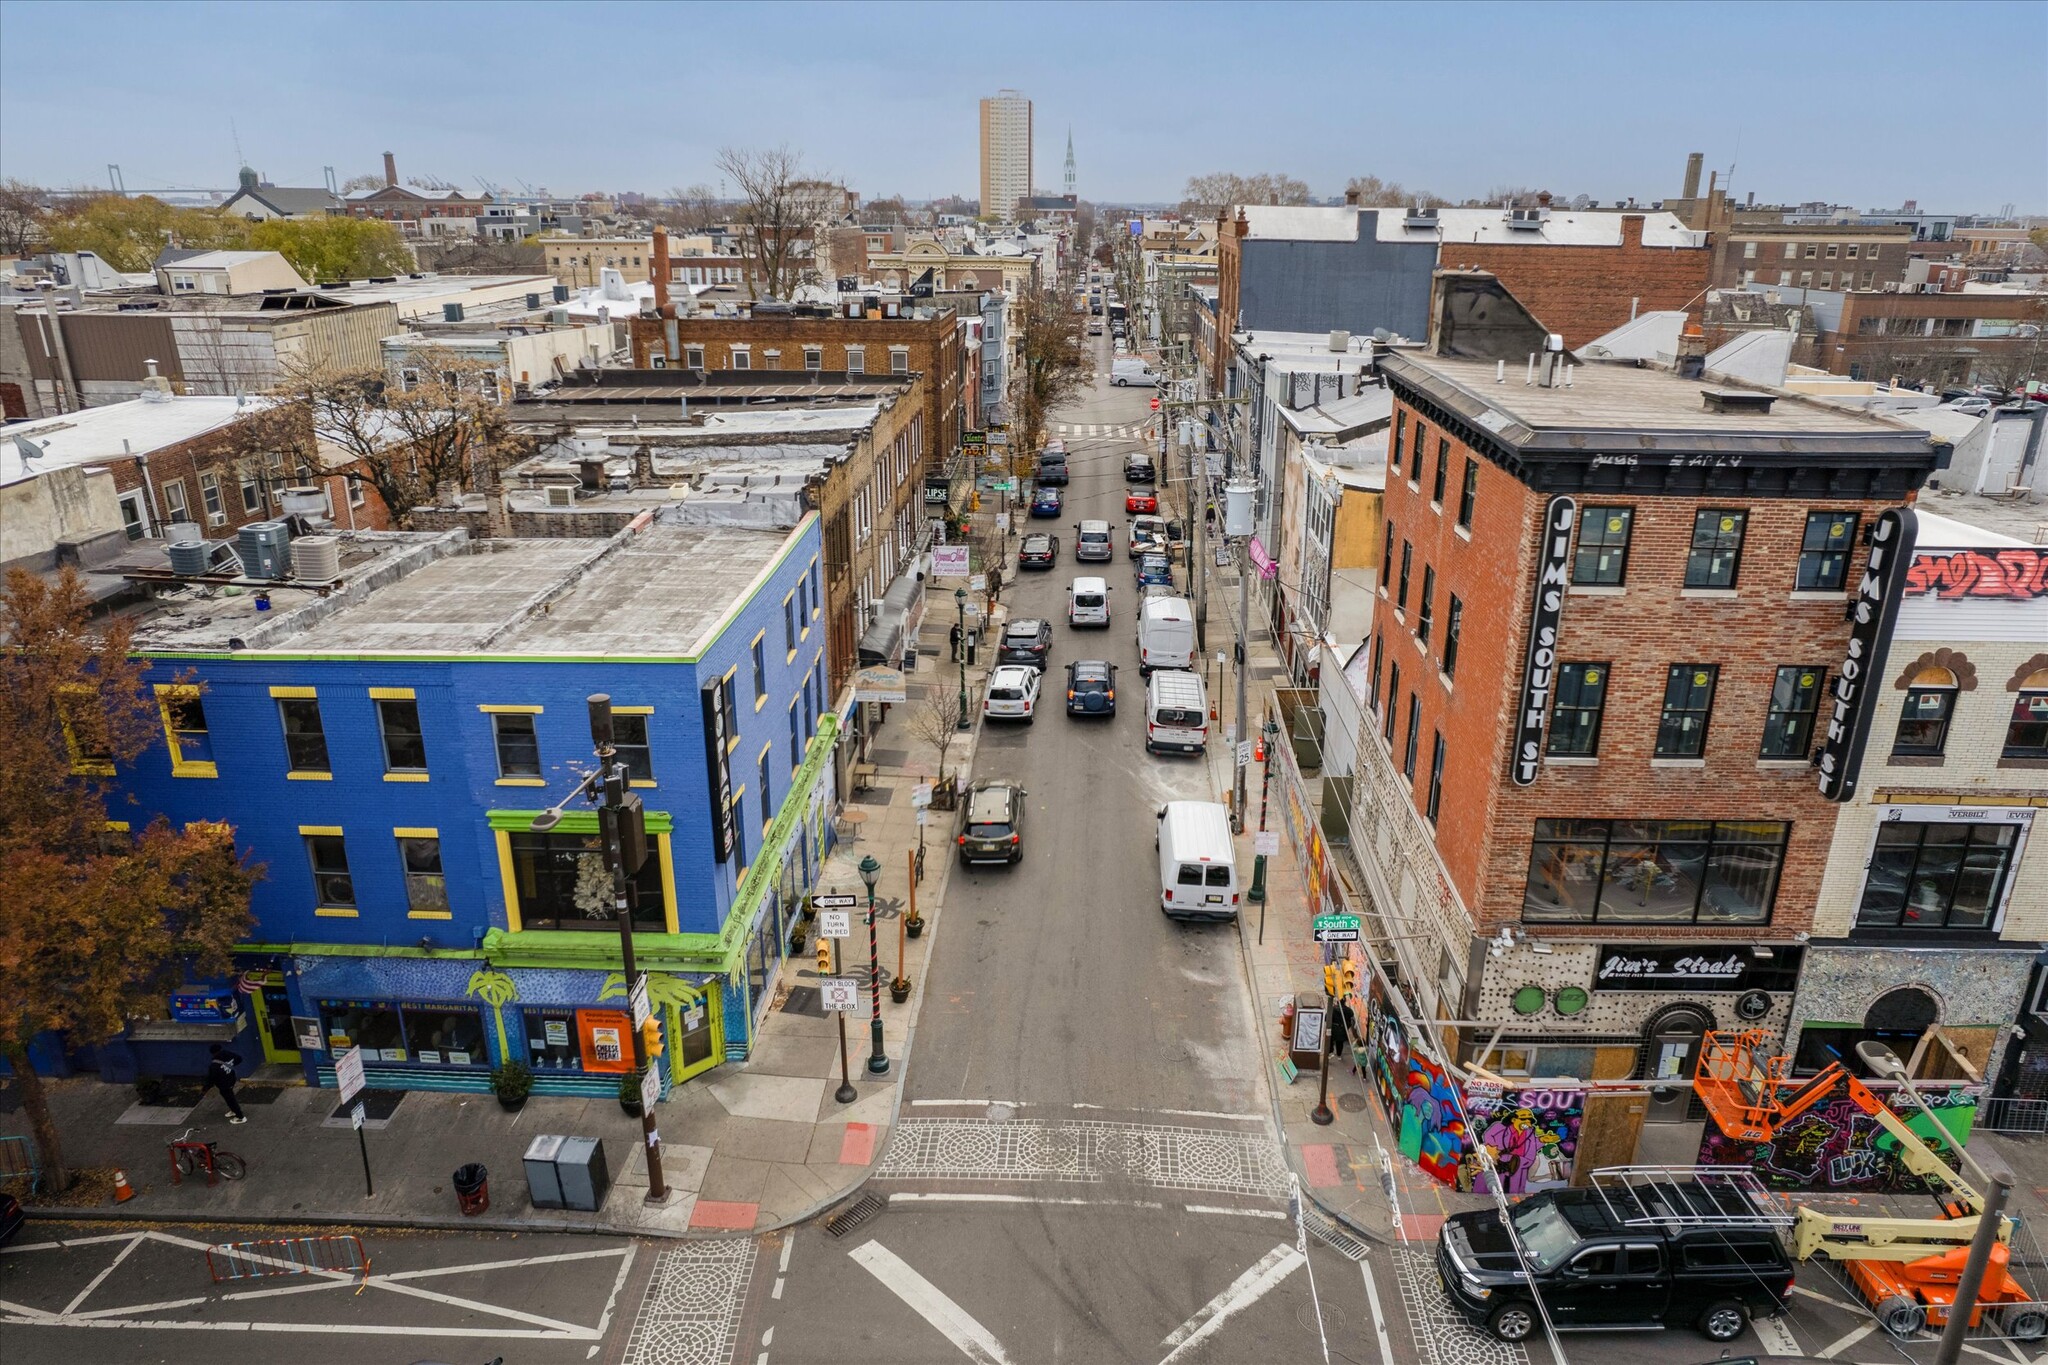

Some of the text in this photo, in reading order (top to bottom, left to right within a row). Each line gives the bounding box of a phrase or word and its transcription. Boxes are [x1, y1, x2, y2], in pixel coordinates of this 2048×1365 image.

[925, 488, 947, 497] CLIPSE
[1519, 508, 1574, 780] JIMS SOUTH ST
[1818, 519, 1893, 794] JIMS SOUTH ST
[1239, 752, 1250, 764] 25
[1323, 919, 1359, 928] South St
[1599, 954, 1746, 980] Jim's Steaks
[424, 1003, 479, 1012] MARGARITAS
[824, 1002, 856, 1010] THE BOX
[596, 1044, 618, 1053] CHEESE
[1741, 1130, 1763, 1138] JLG
